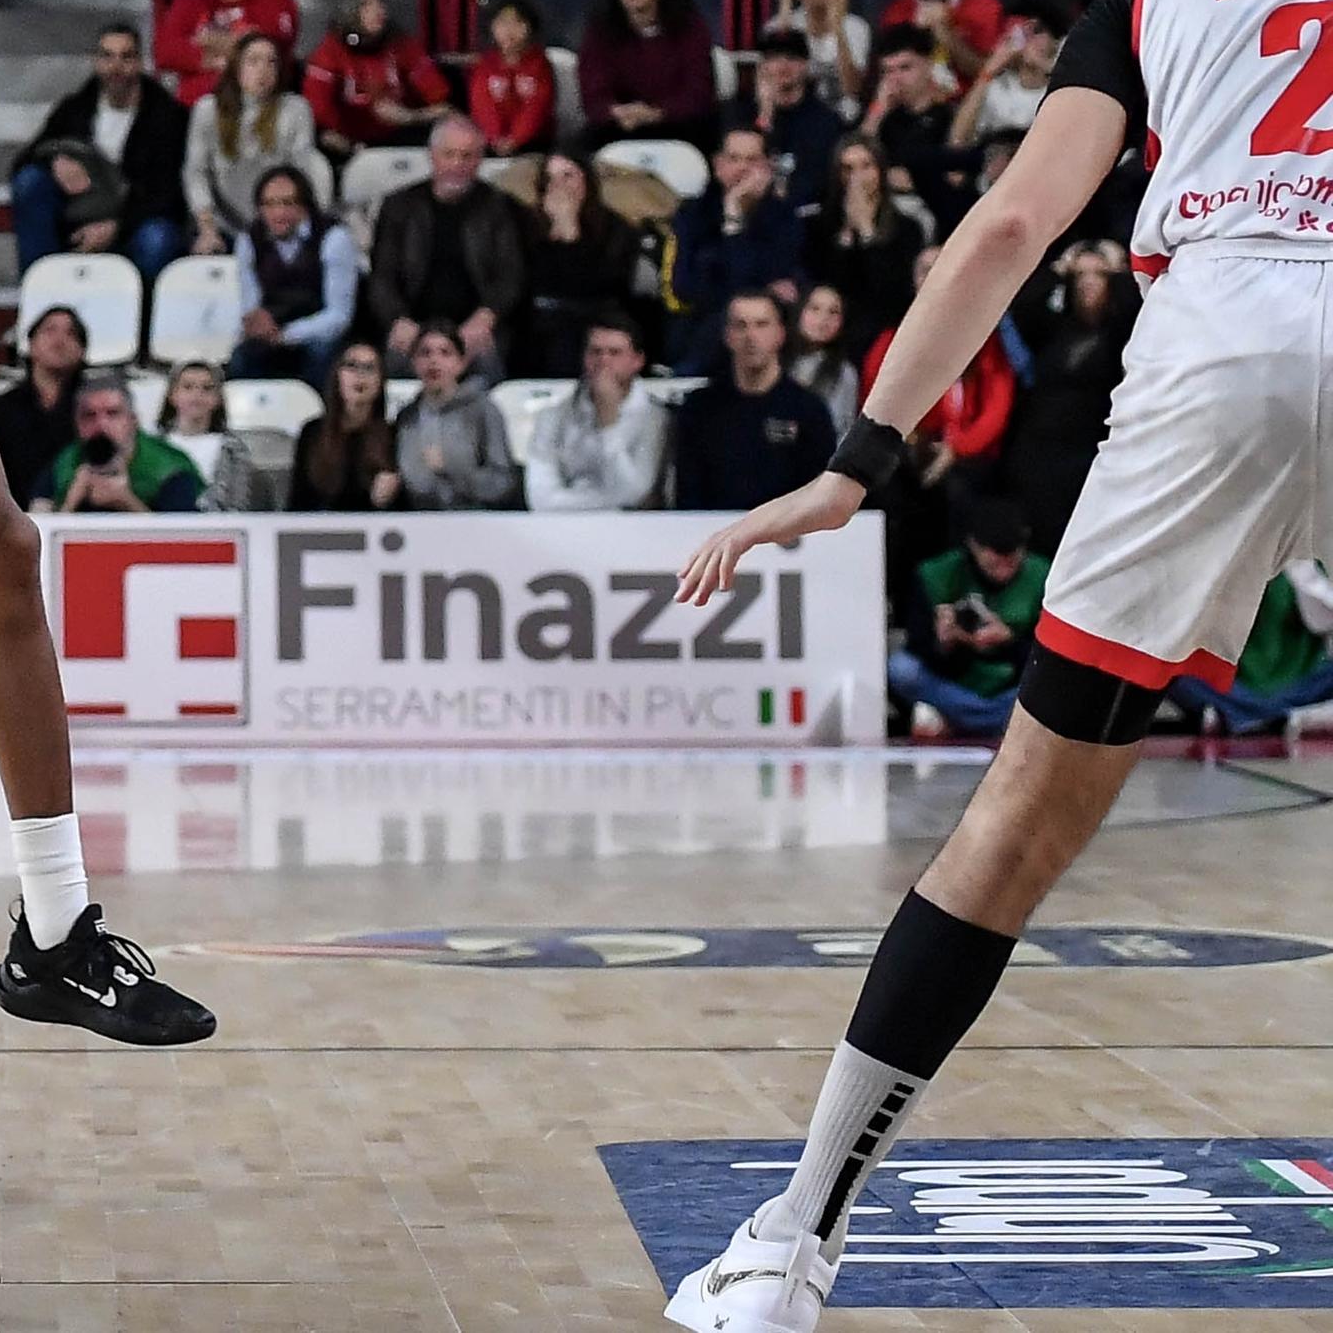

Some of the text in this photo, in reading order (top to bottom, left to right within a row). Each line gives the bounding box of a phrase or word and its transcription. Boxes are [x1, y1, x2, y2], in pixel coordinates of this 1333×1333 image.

[1249, 0, 1333, 157] 2
[1264, 207, 1290, 221] by
[276, 529, 804, 661] Finazzi
[275, 685, 735, 732] SERRAMENTI IN PVC
